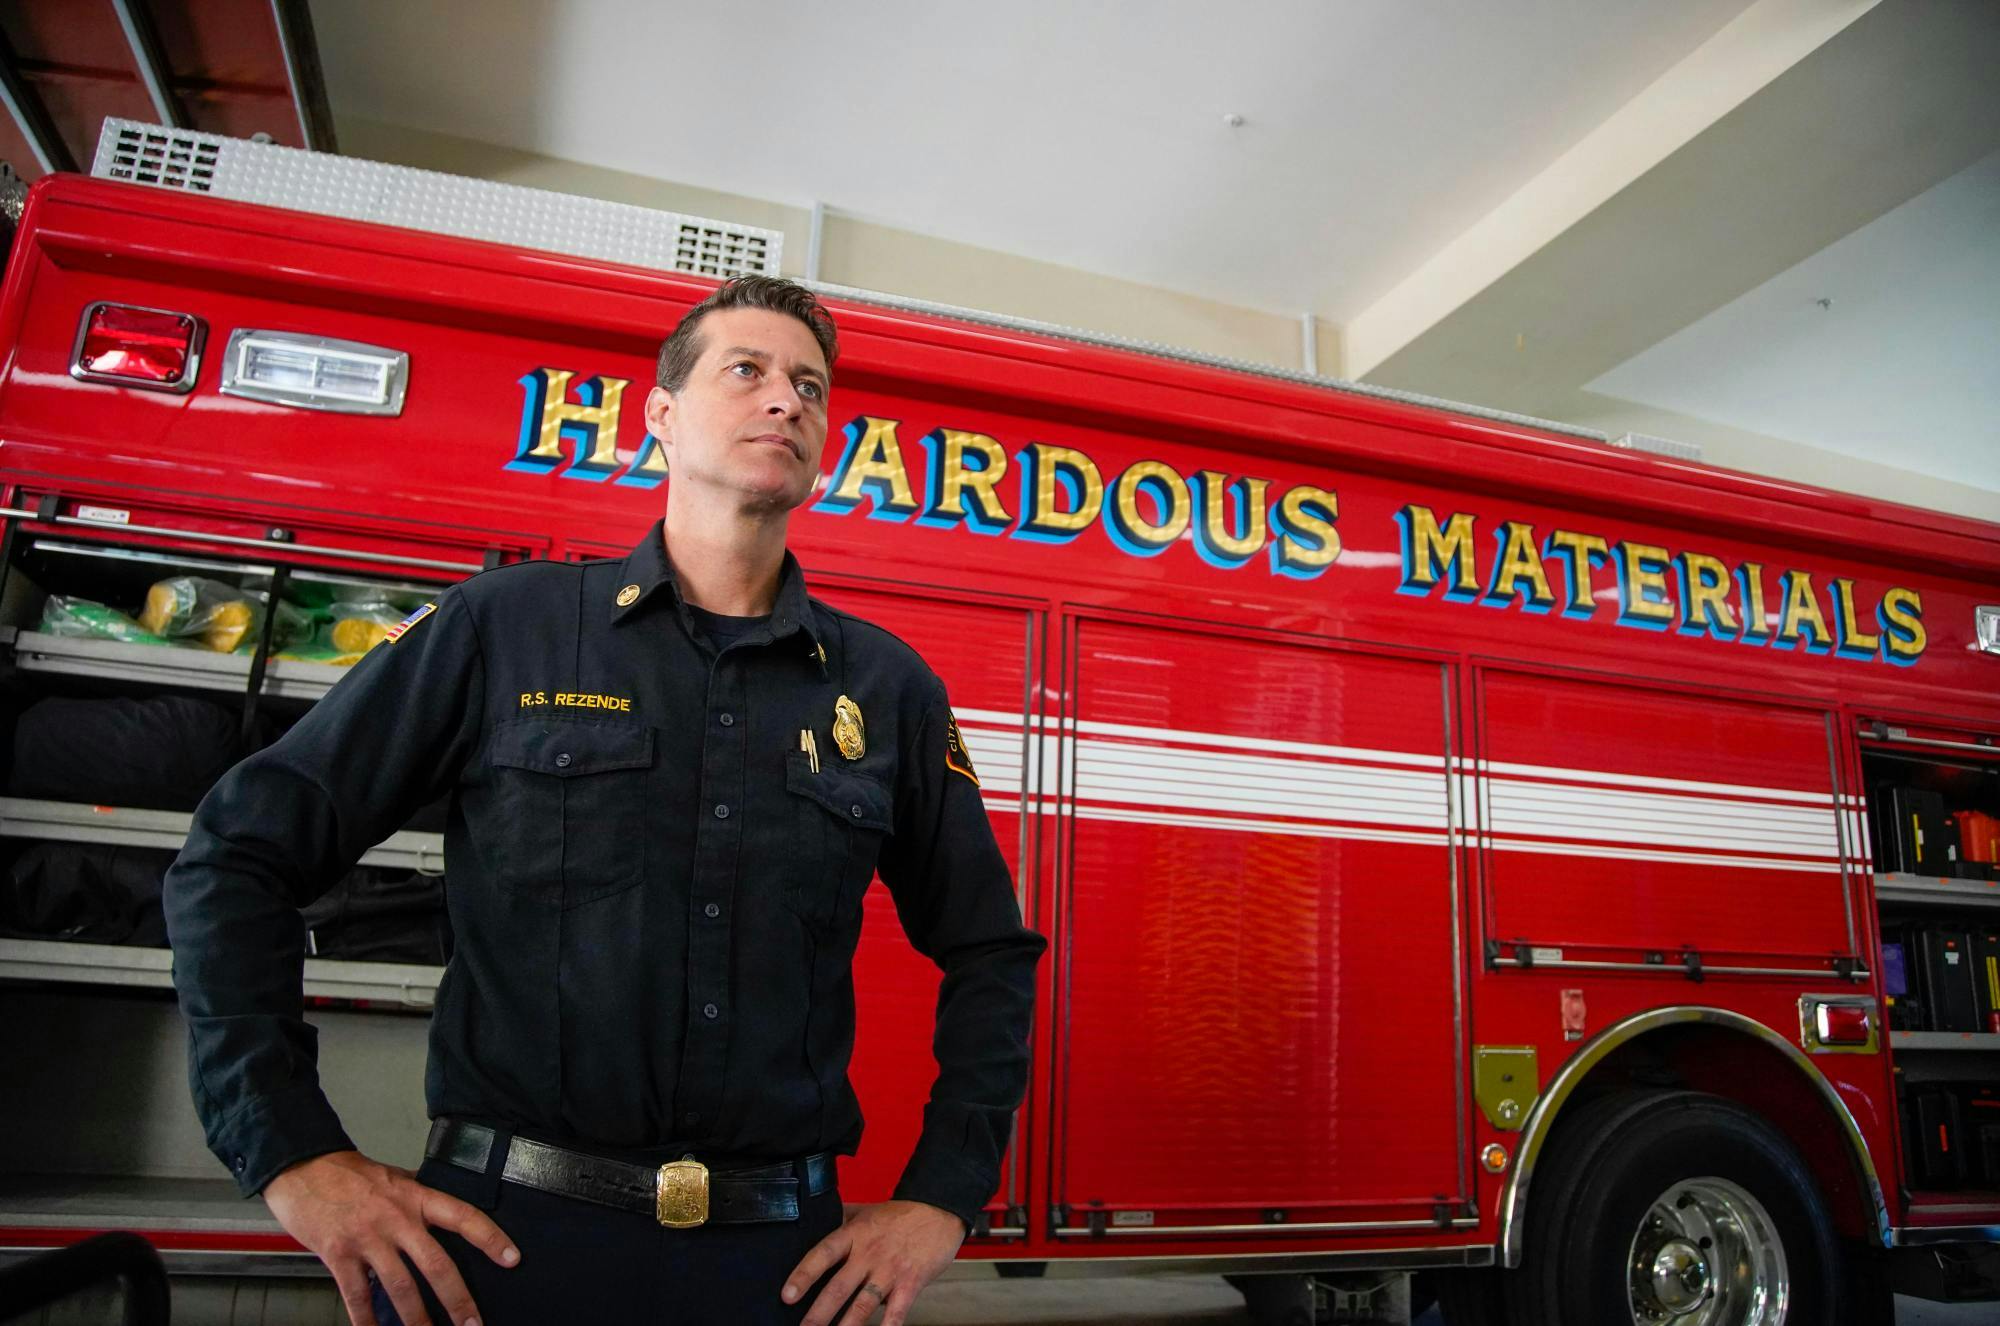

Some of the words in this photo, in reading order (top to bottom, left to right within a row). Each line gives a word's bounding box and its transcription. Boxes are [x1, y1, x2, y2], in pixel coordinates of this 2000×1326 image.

[506, 366, 1342, 578] HARDOUS
[1395, 504, 1927, 666] MATERIALS
[520, 692, 548, 707] R.S.
[555, 693, 631, 712] REZENDE
